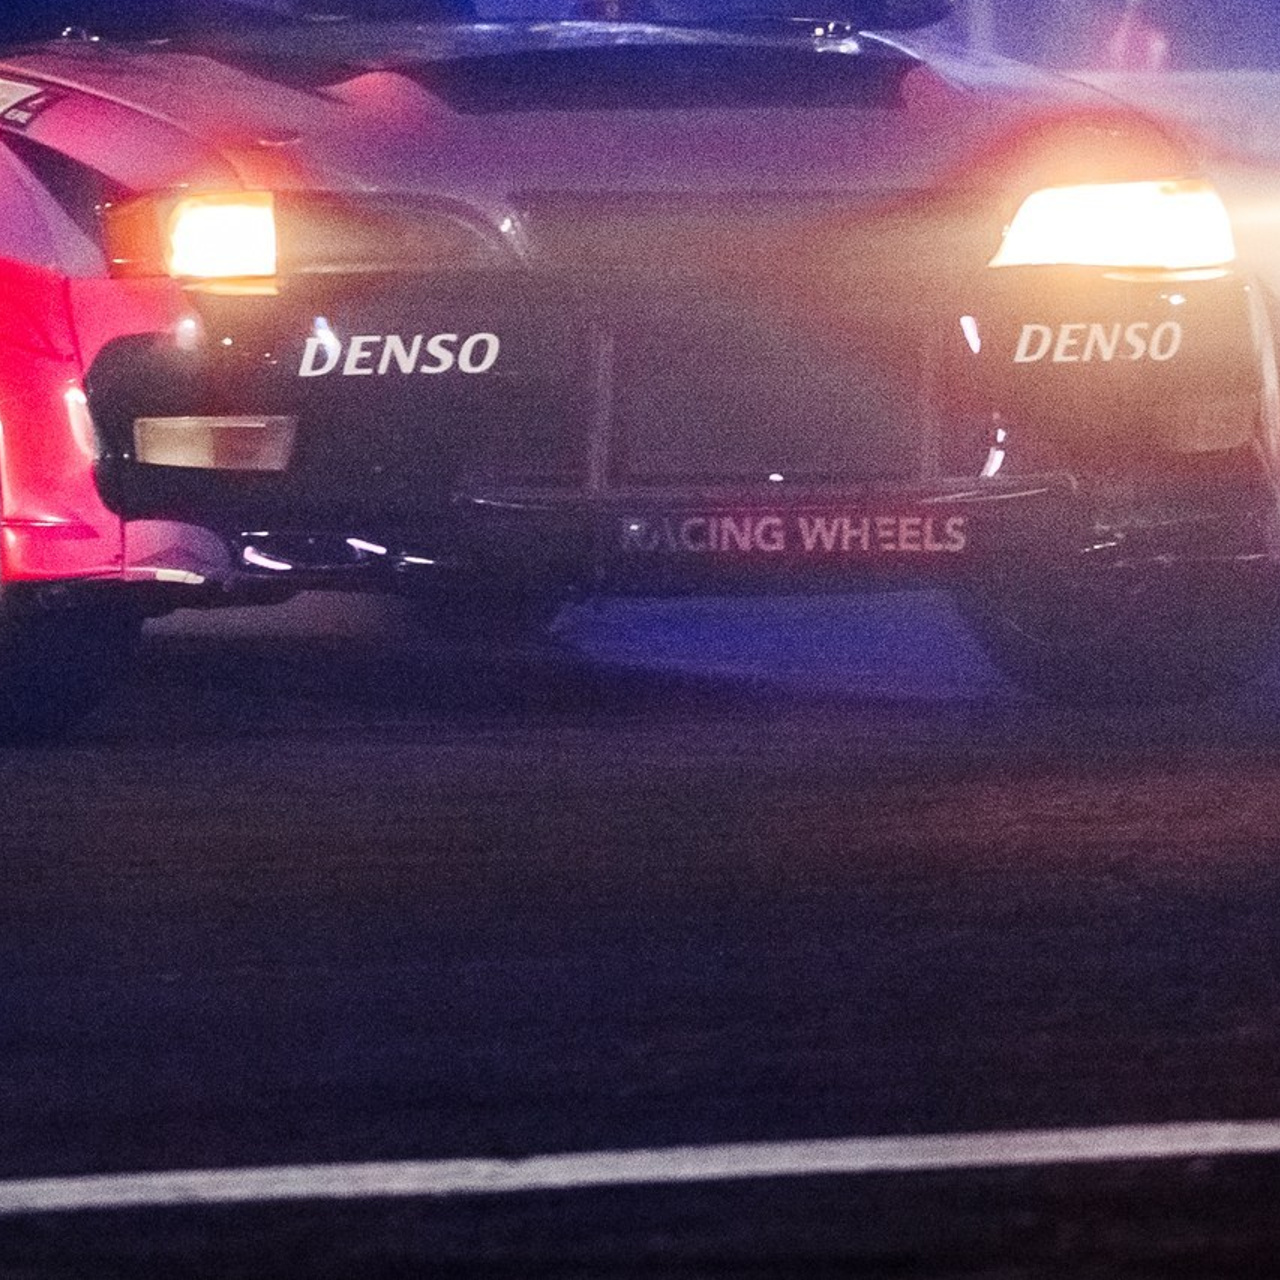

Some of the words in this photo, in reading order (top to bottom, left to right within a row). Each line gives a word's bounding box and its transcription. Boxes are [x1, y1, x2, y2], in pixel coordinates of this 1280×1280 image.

[298, 332, 501, 377] DENSO
[1014, 321, 1183, 363] DENSO
[798, 516, 968, 552] WHEELS
